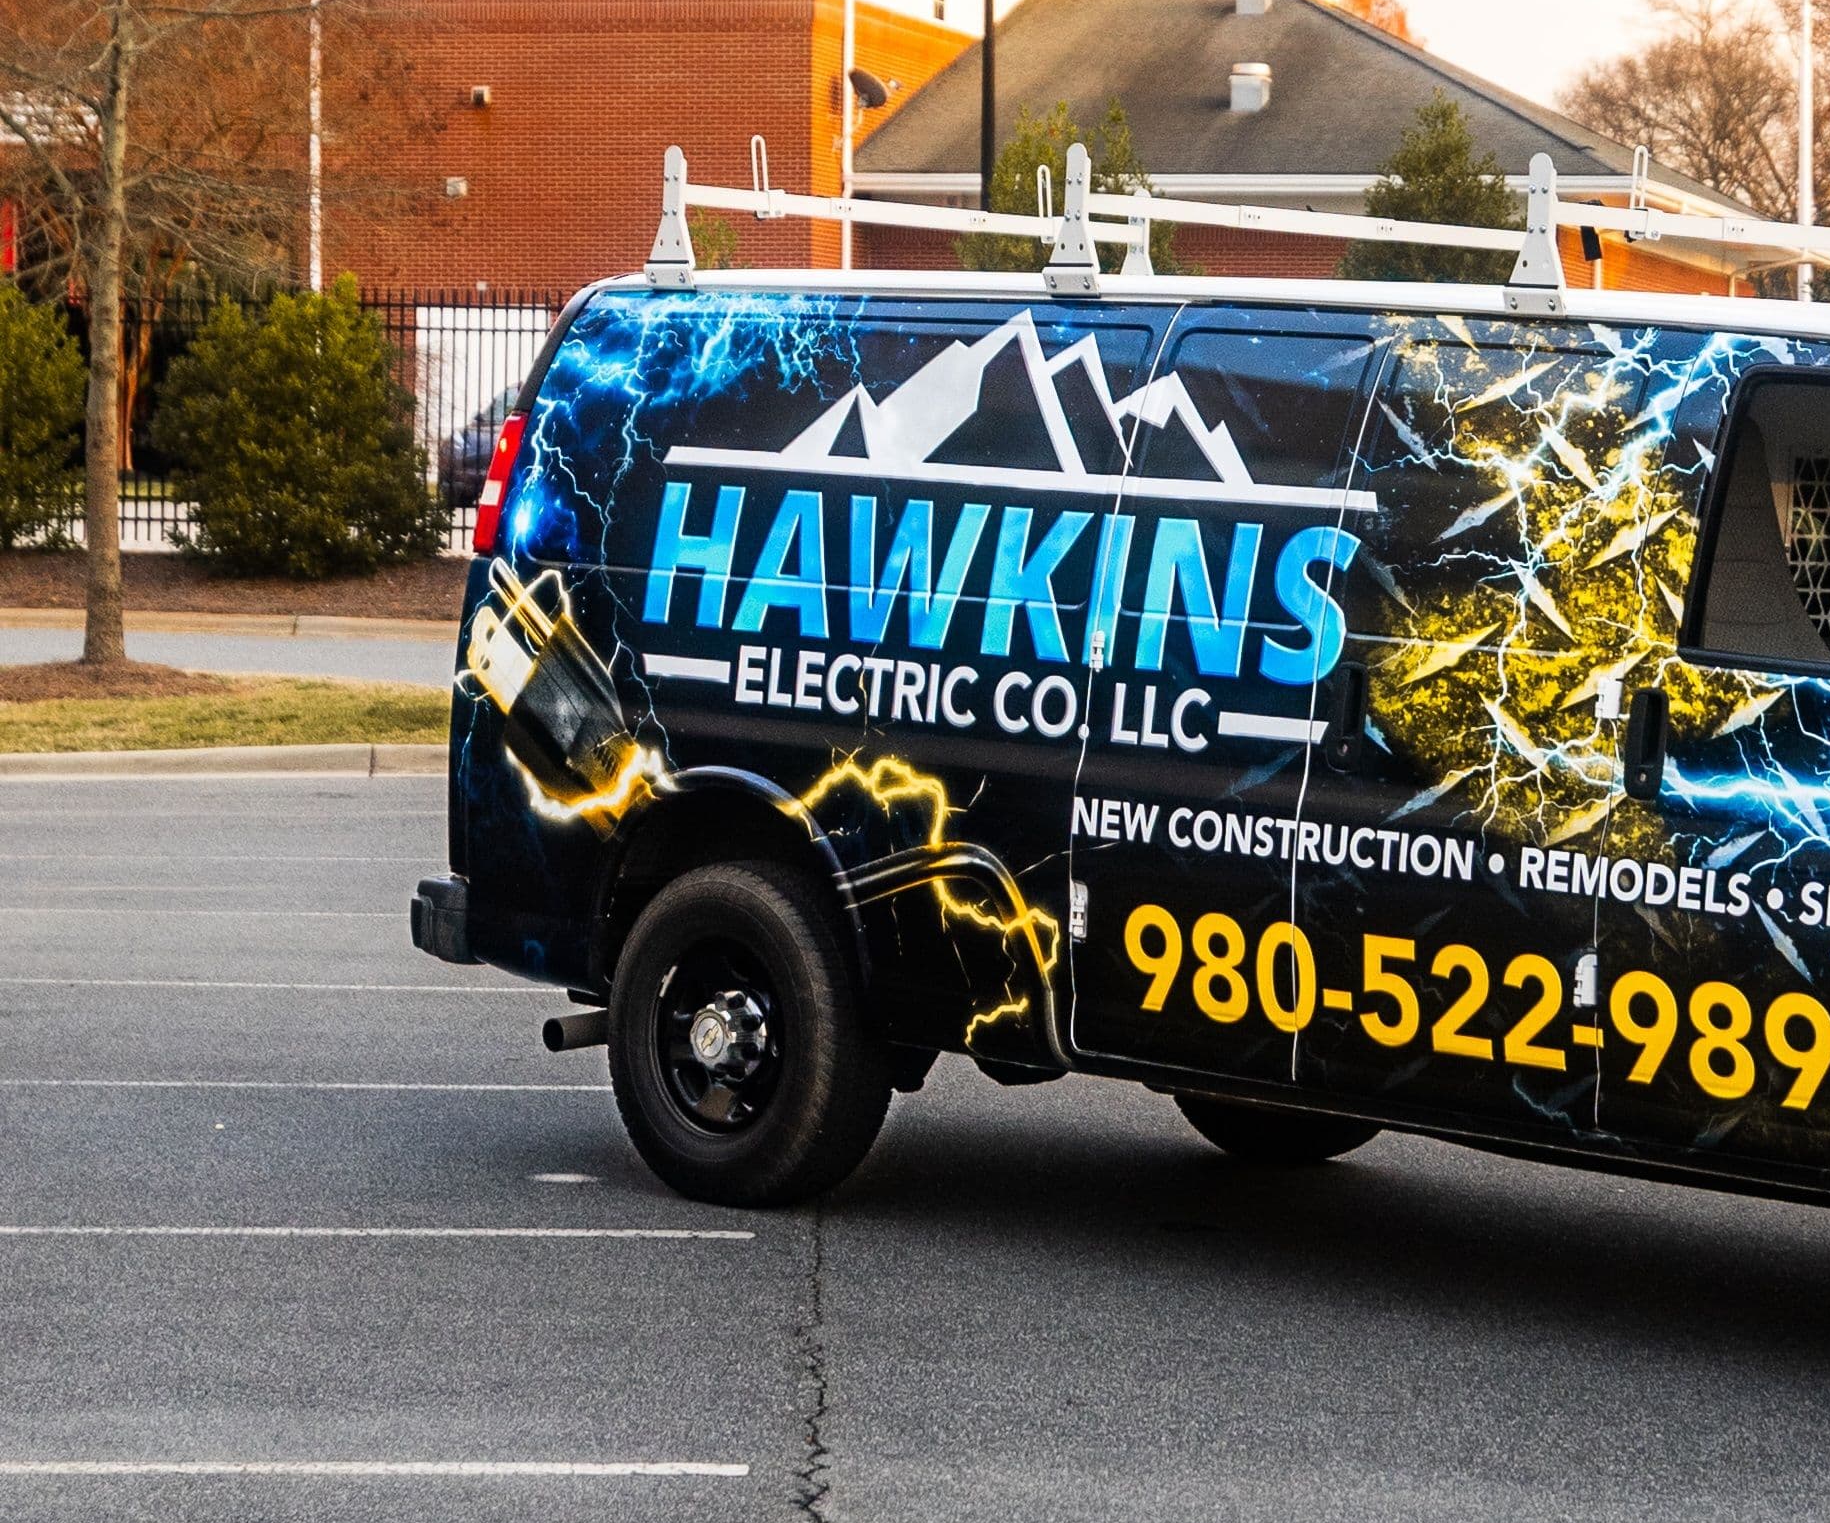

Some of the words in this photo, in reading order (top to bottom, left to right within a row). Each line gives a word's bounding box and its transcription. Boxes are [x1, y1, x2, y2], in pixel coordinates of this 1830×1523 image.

[642, 482, 1361, 686] HAWKINS
[735, 646, 978, 728] ELECTRIC
[1110, 682, 1211, 753] LLC
[1071, 796, 1163, 843] NEW
[1168, 809, 1474, 881] CONSTRUCTION
[1518, 847, 1752, 918] REMODELS
